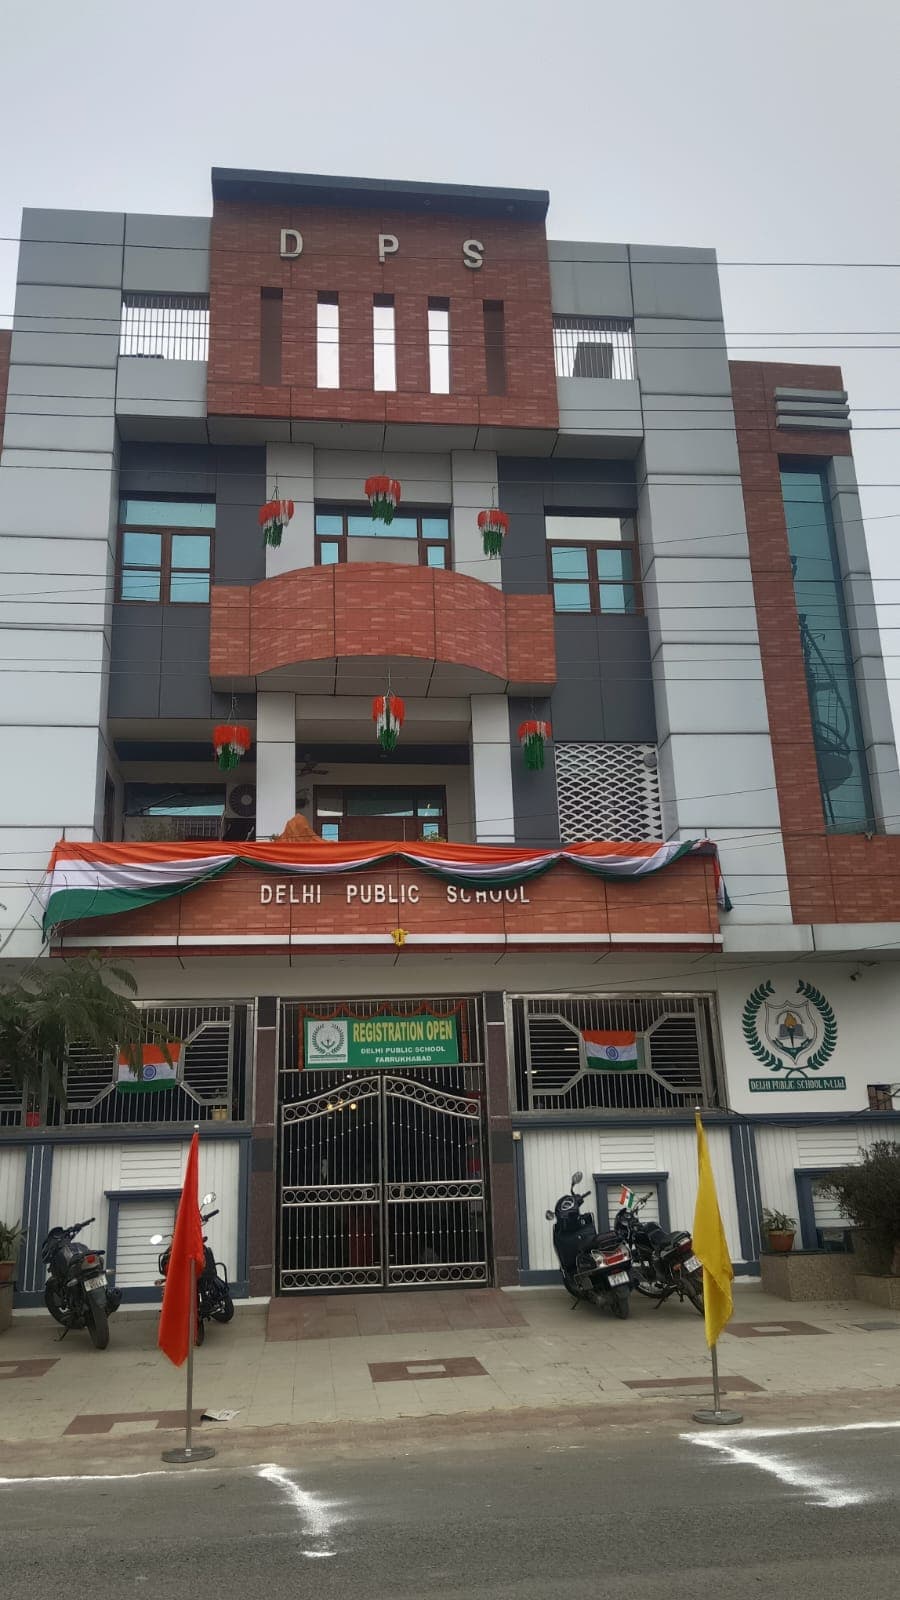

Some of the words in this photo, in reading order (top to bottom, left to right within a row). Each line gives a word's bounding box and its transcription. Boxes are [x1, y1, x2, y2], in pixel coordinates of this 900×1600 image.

[280, 228, 303, 258] D
[378, 234, 399, 262] P
[462, 239, 484, 268] S
[260, 884, 322, 904] DELHI
[346, 884, 420, 904] PUBLIC
[353, 1021, 424, 1043] REGISTRATION
[426, 1020, 453, 1041] OPEN
[360, 1047, 384, 1055] DELHI
[385, 1046, 413, 1054] PUBLIC
[415, 1045, 446, 1053] SCHOOL
[375, 1055, 432, 1063] FARRUKHABAD
[750, 1080, 771, 1090] DELHI
[772, 1080, 795, 1090] PUBLIC
[797, 1079, 823, 1089] SCHOOL
